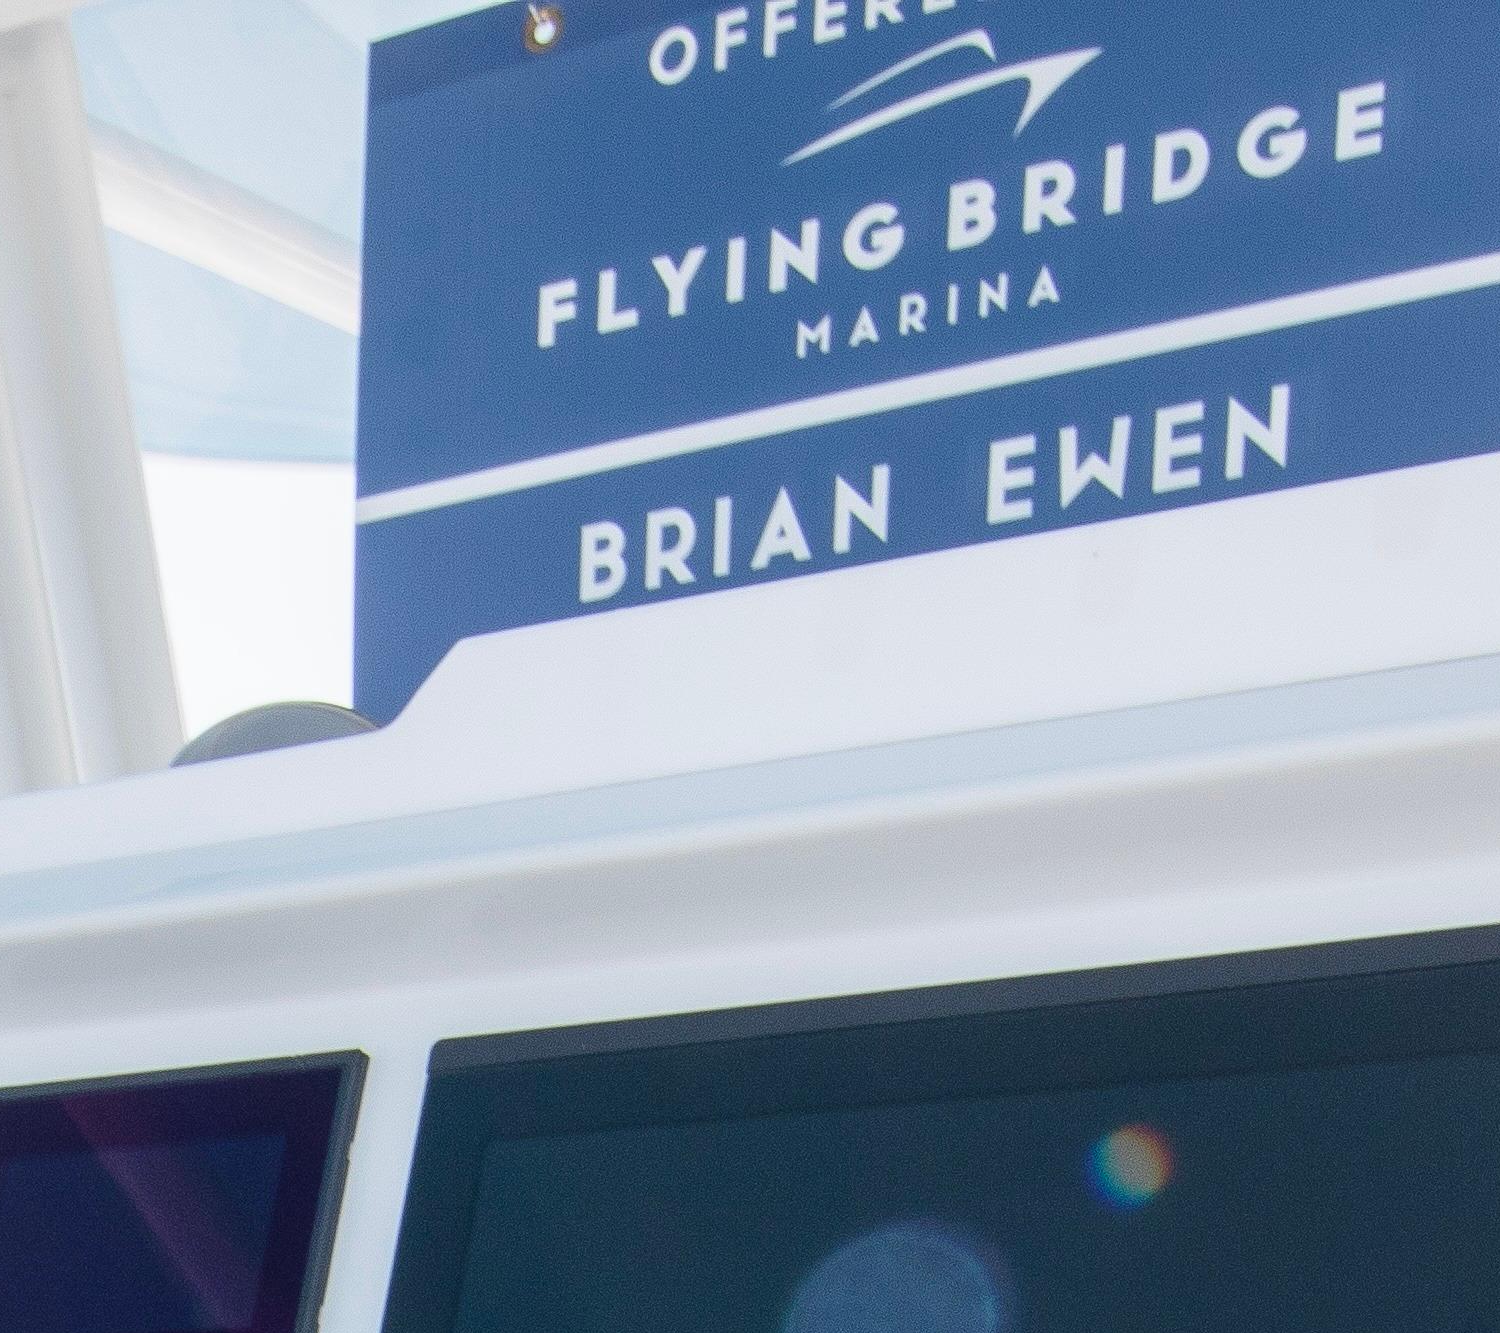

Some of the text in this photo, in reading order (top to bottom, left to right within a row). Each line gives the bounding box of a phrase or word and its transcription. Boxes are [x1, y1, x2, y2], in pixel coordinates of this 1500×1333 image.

[648, 0, 956, 86] OFFER
[537, 82, 1386, 348] FLYING BRIDGE
[798, 266, 1060, 358] MARINA
[579, 383, 1290, 604] BRIAN EWEN
